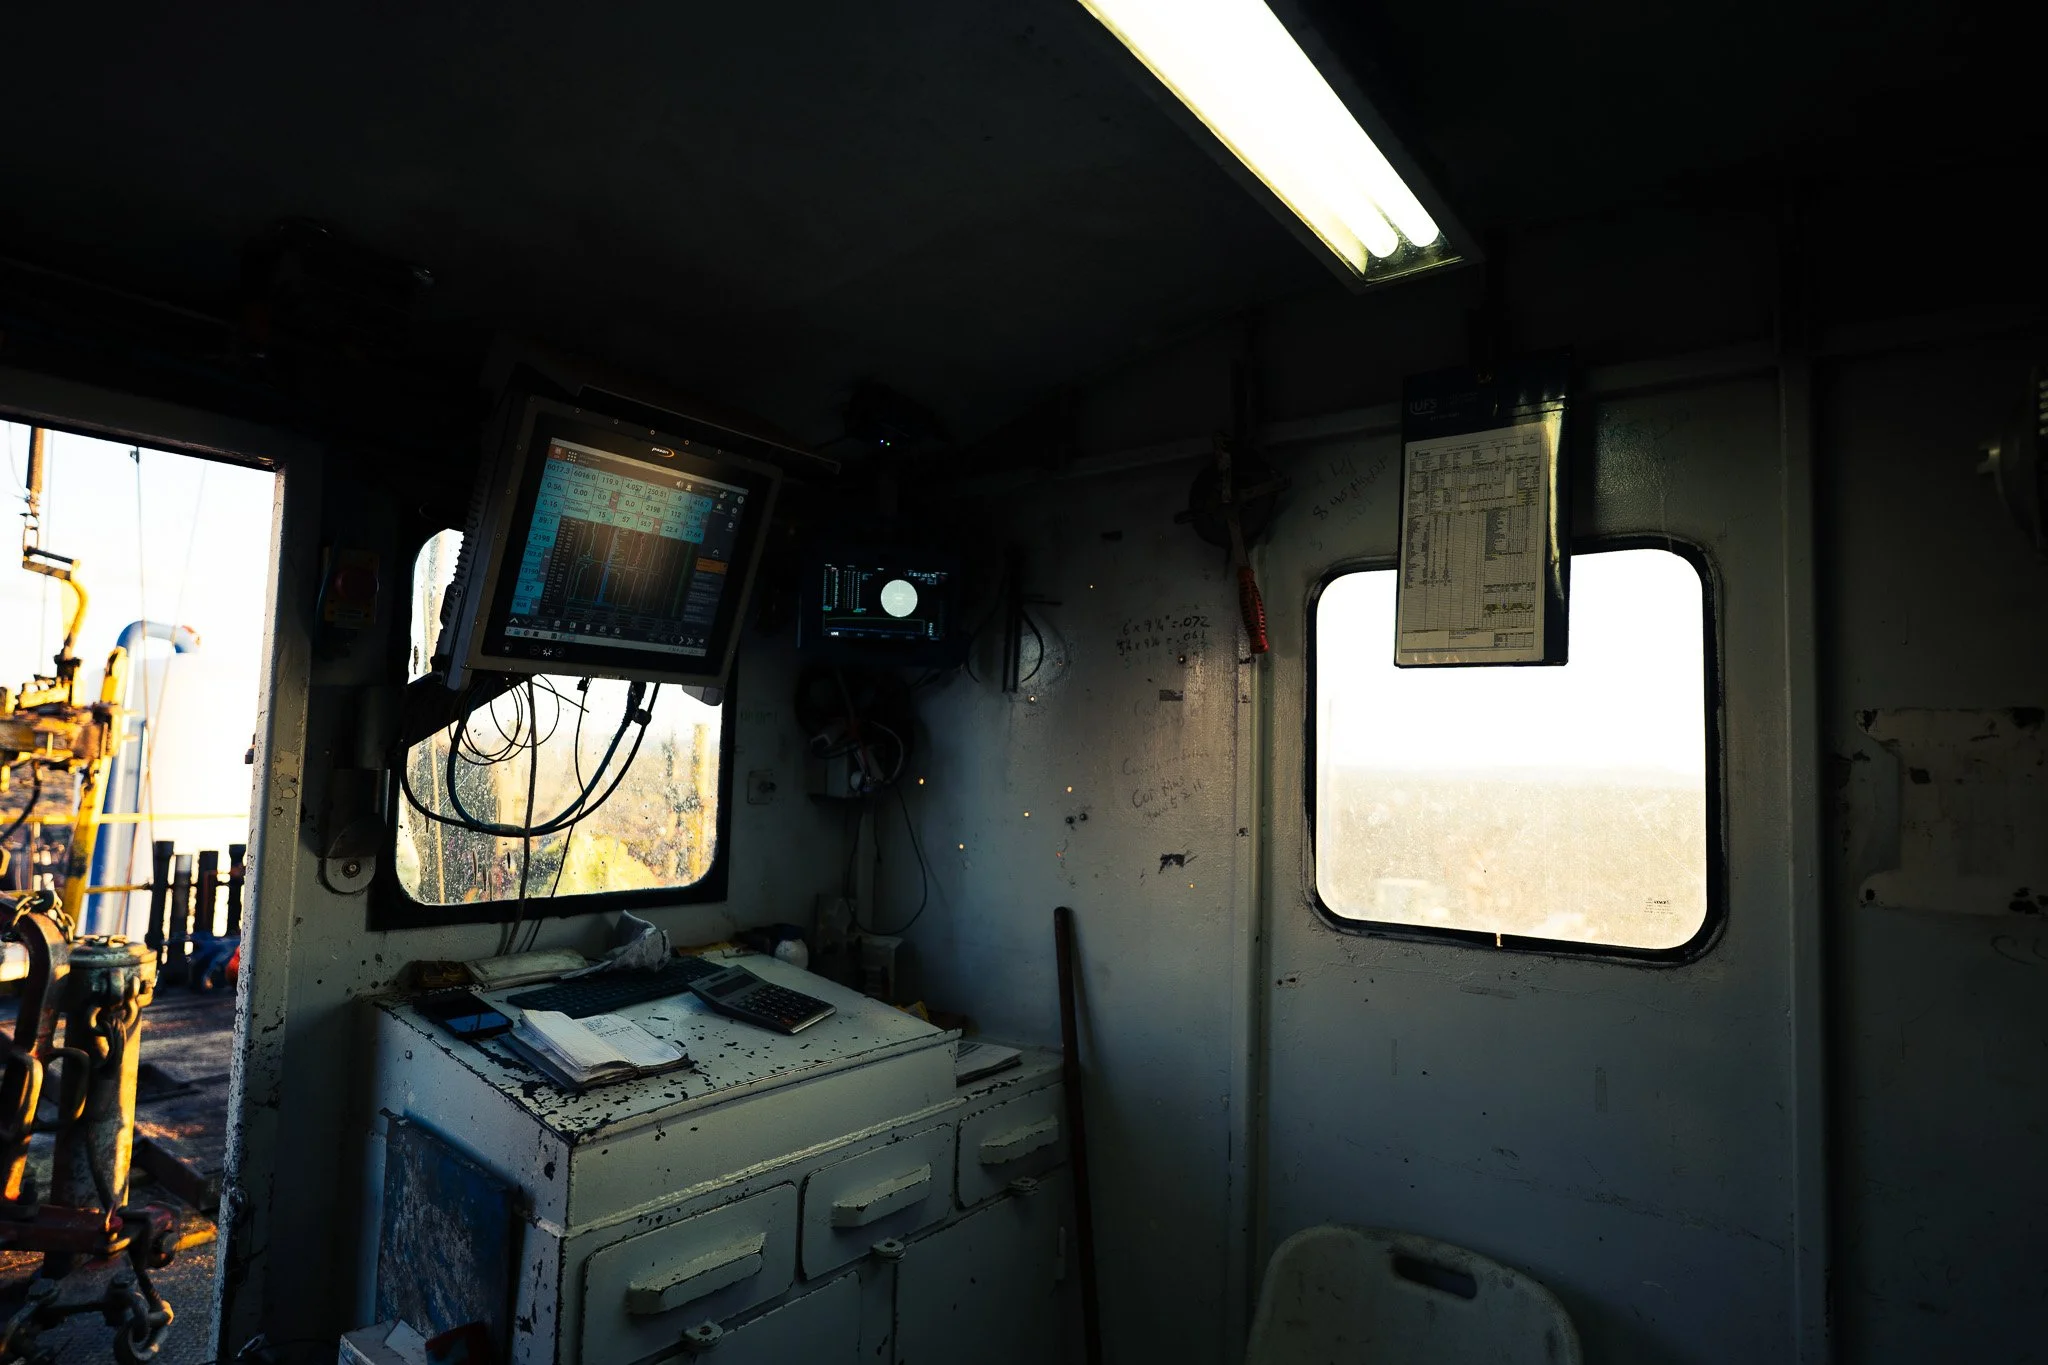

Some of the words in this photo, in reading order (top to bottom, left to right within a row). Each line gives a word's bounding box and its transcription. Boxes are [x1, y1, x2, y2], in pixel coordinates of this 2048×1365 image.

[602, 477, 619, 486] 119.9
[573, 488, 588, 497] 0.00
[647, 488, 667, 498] 250.51
